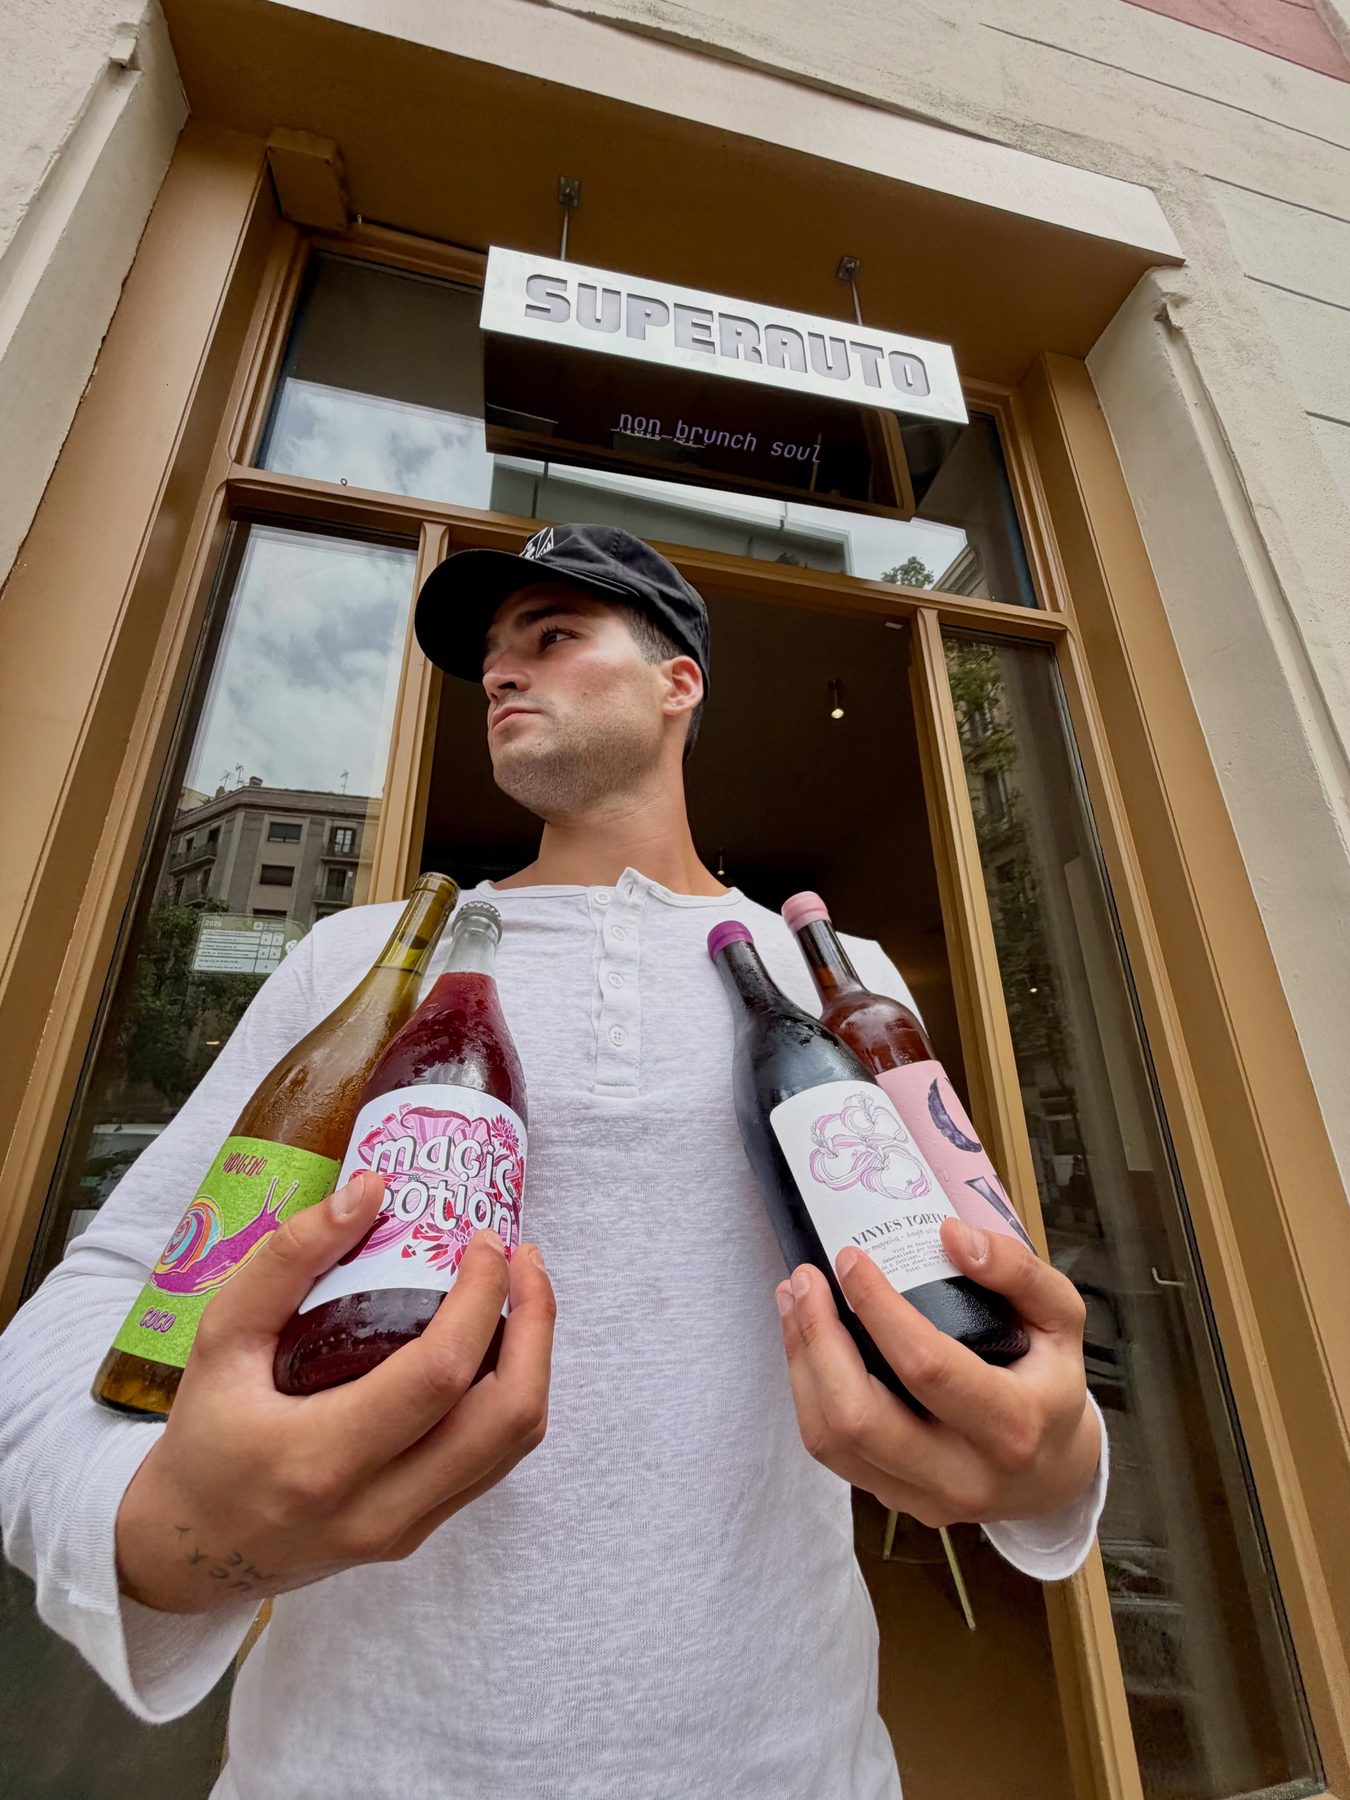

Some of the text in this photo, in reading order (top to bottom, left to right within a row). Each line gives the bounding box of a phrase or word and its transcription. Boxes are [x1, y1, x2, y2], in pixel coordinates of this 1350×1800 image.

[525, 274, 931, 397] SUPERAUTO
[619, 413, 821, 464] non brunch soul
[370, 1135, 515, 1204] magic
[851, 1217, 903, 1247] VINYES
[139, 1306, 176, 1333] COCO
